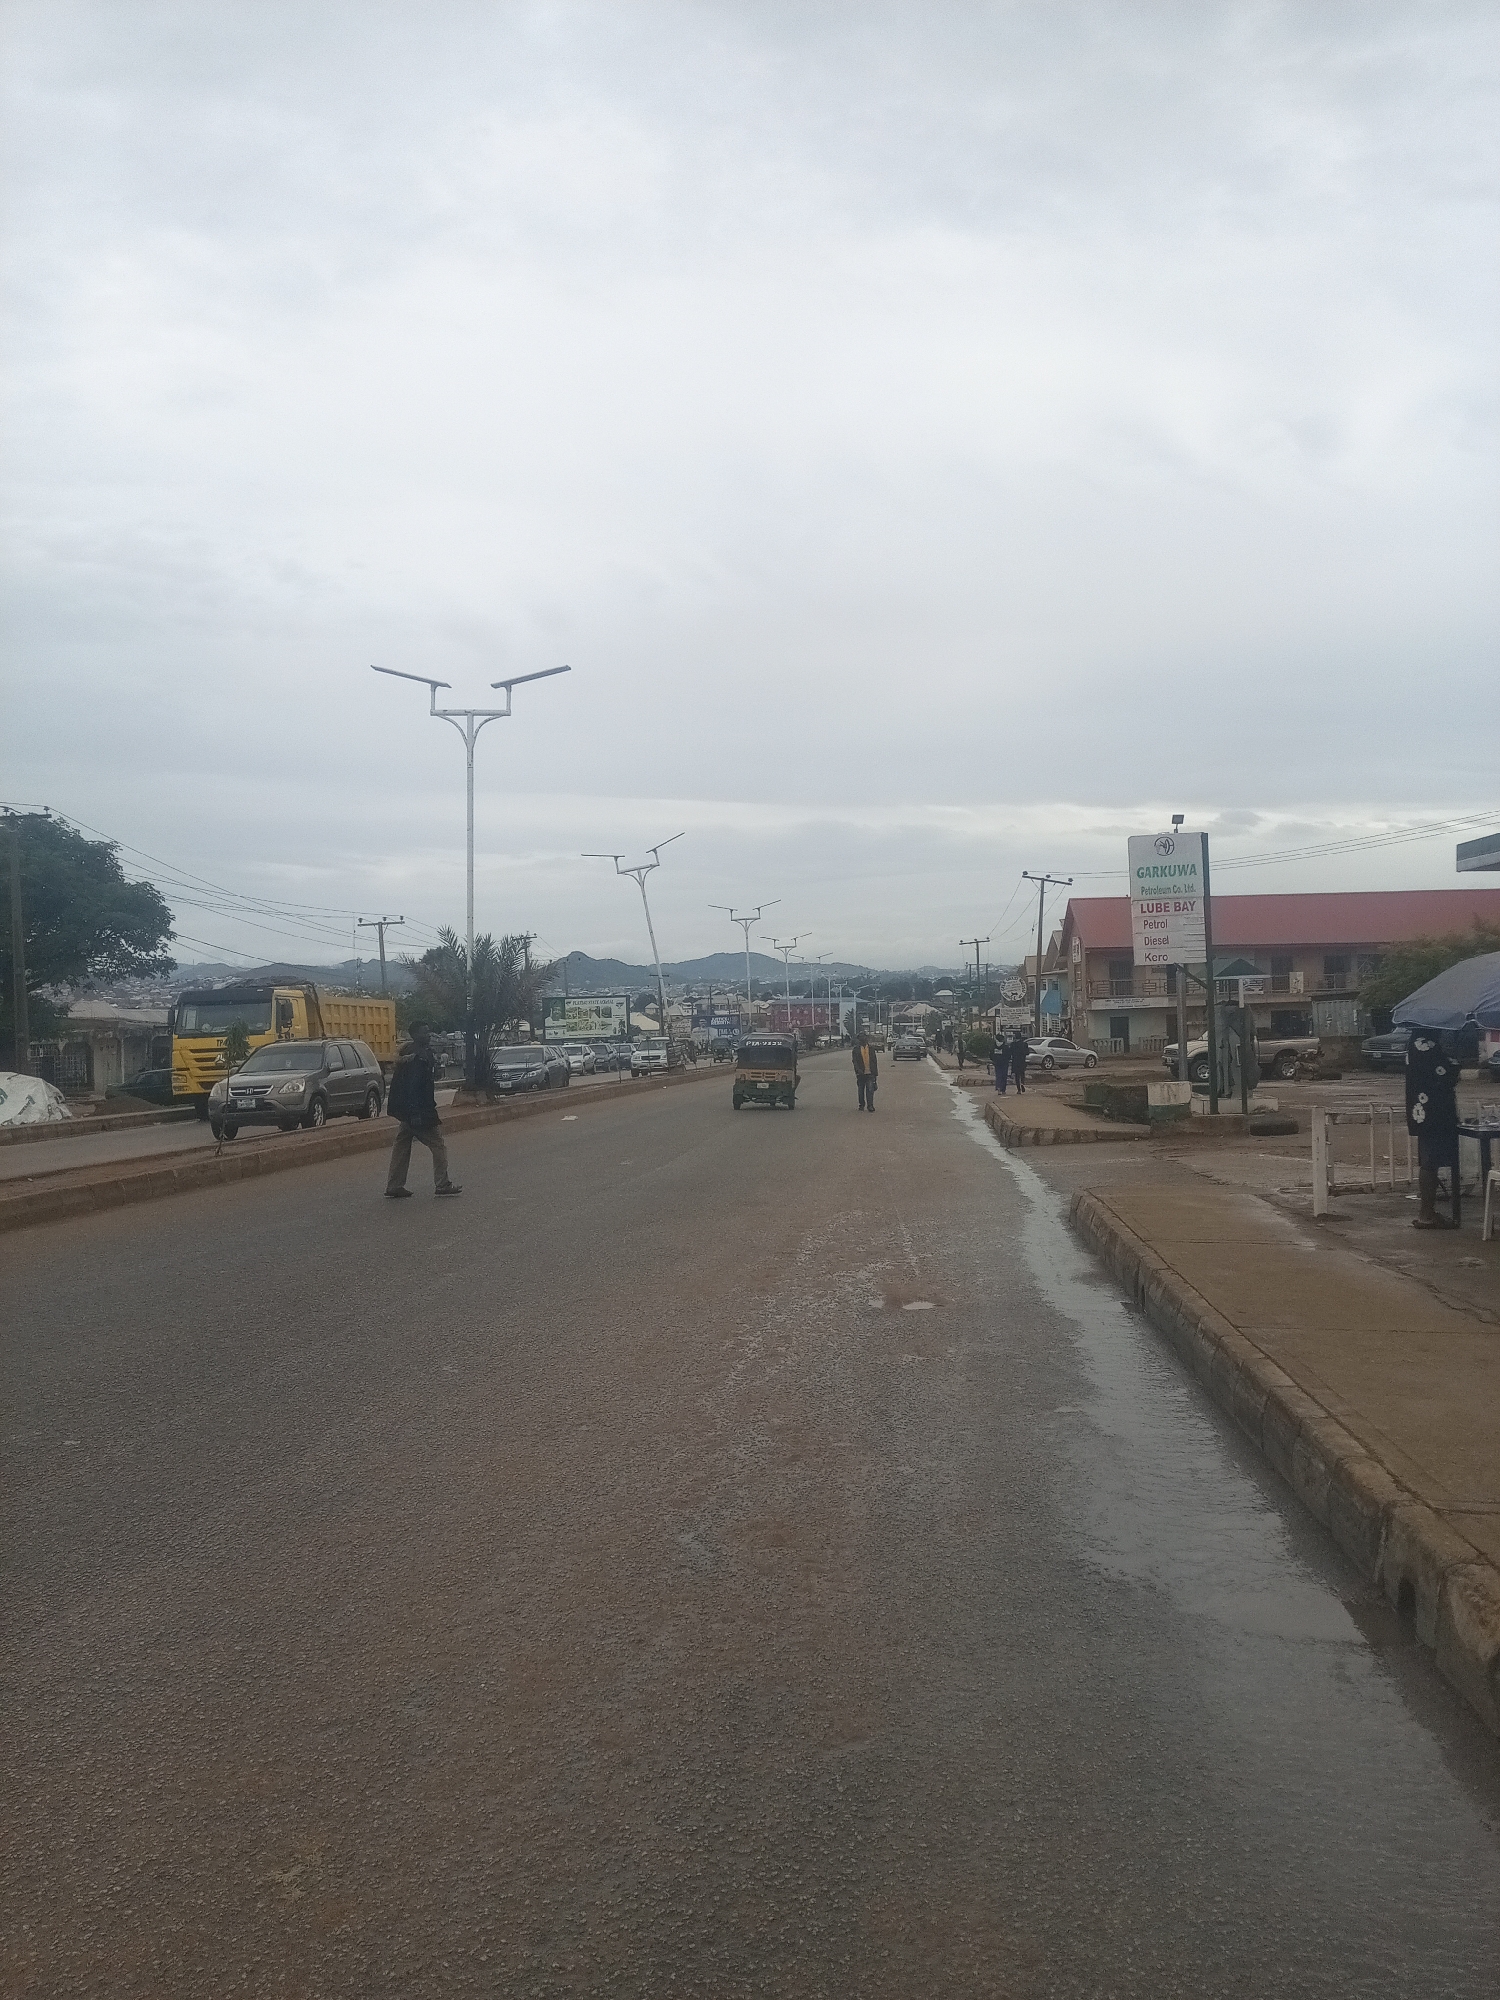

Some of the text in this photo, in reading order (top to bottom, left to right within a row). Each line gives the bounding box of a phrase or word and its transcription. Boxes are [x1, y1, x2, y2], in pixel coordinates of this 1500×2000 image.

[1136, 863, 1197, 879] GARKUWA
[1140, 883, 1197, 896] Petroleum Co. Ltd.
[1140, 901, 1197, 914] LUBE BAY
[1143, 919, 1168, 930] Petrol
[1144, 935, 1170, 946] Diesel
[1144, 952, 1169, 962] Kero
